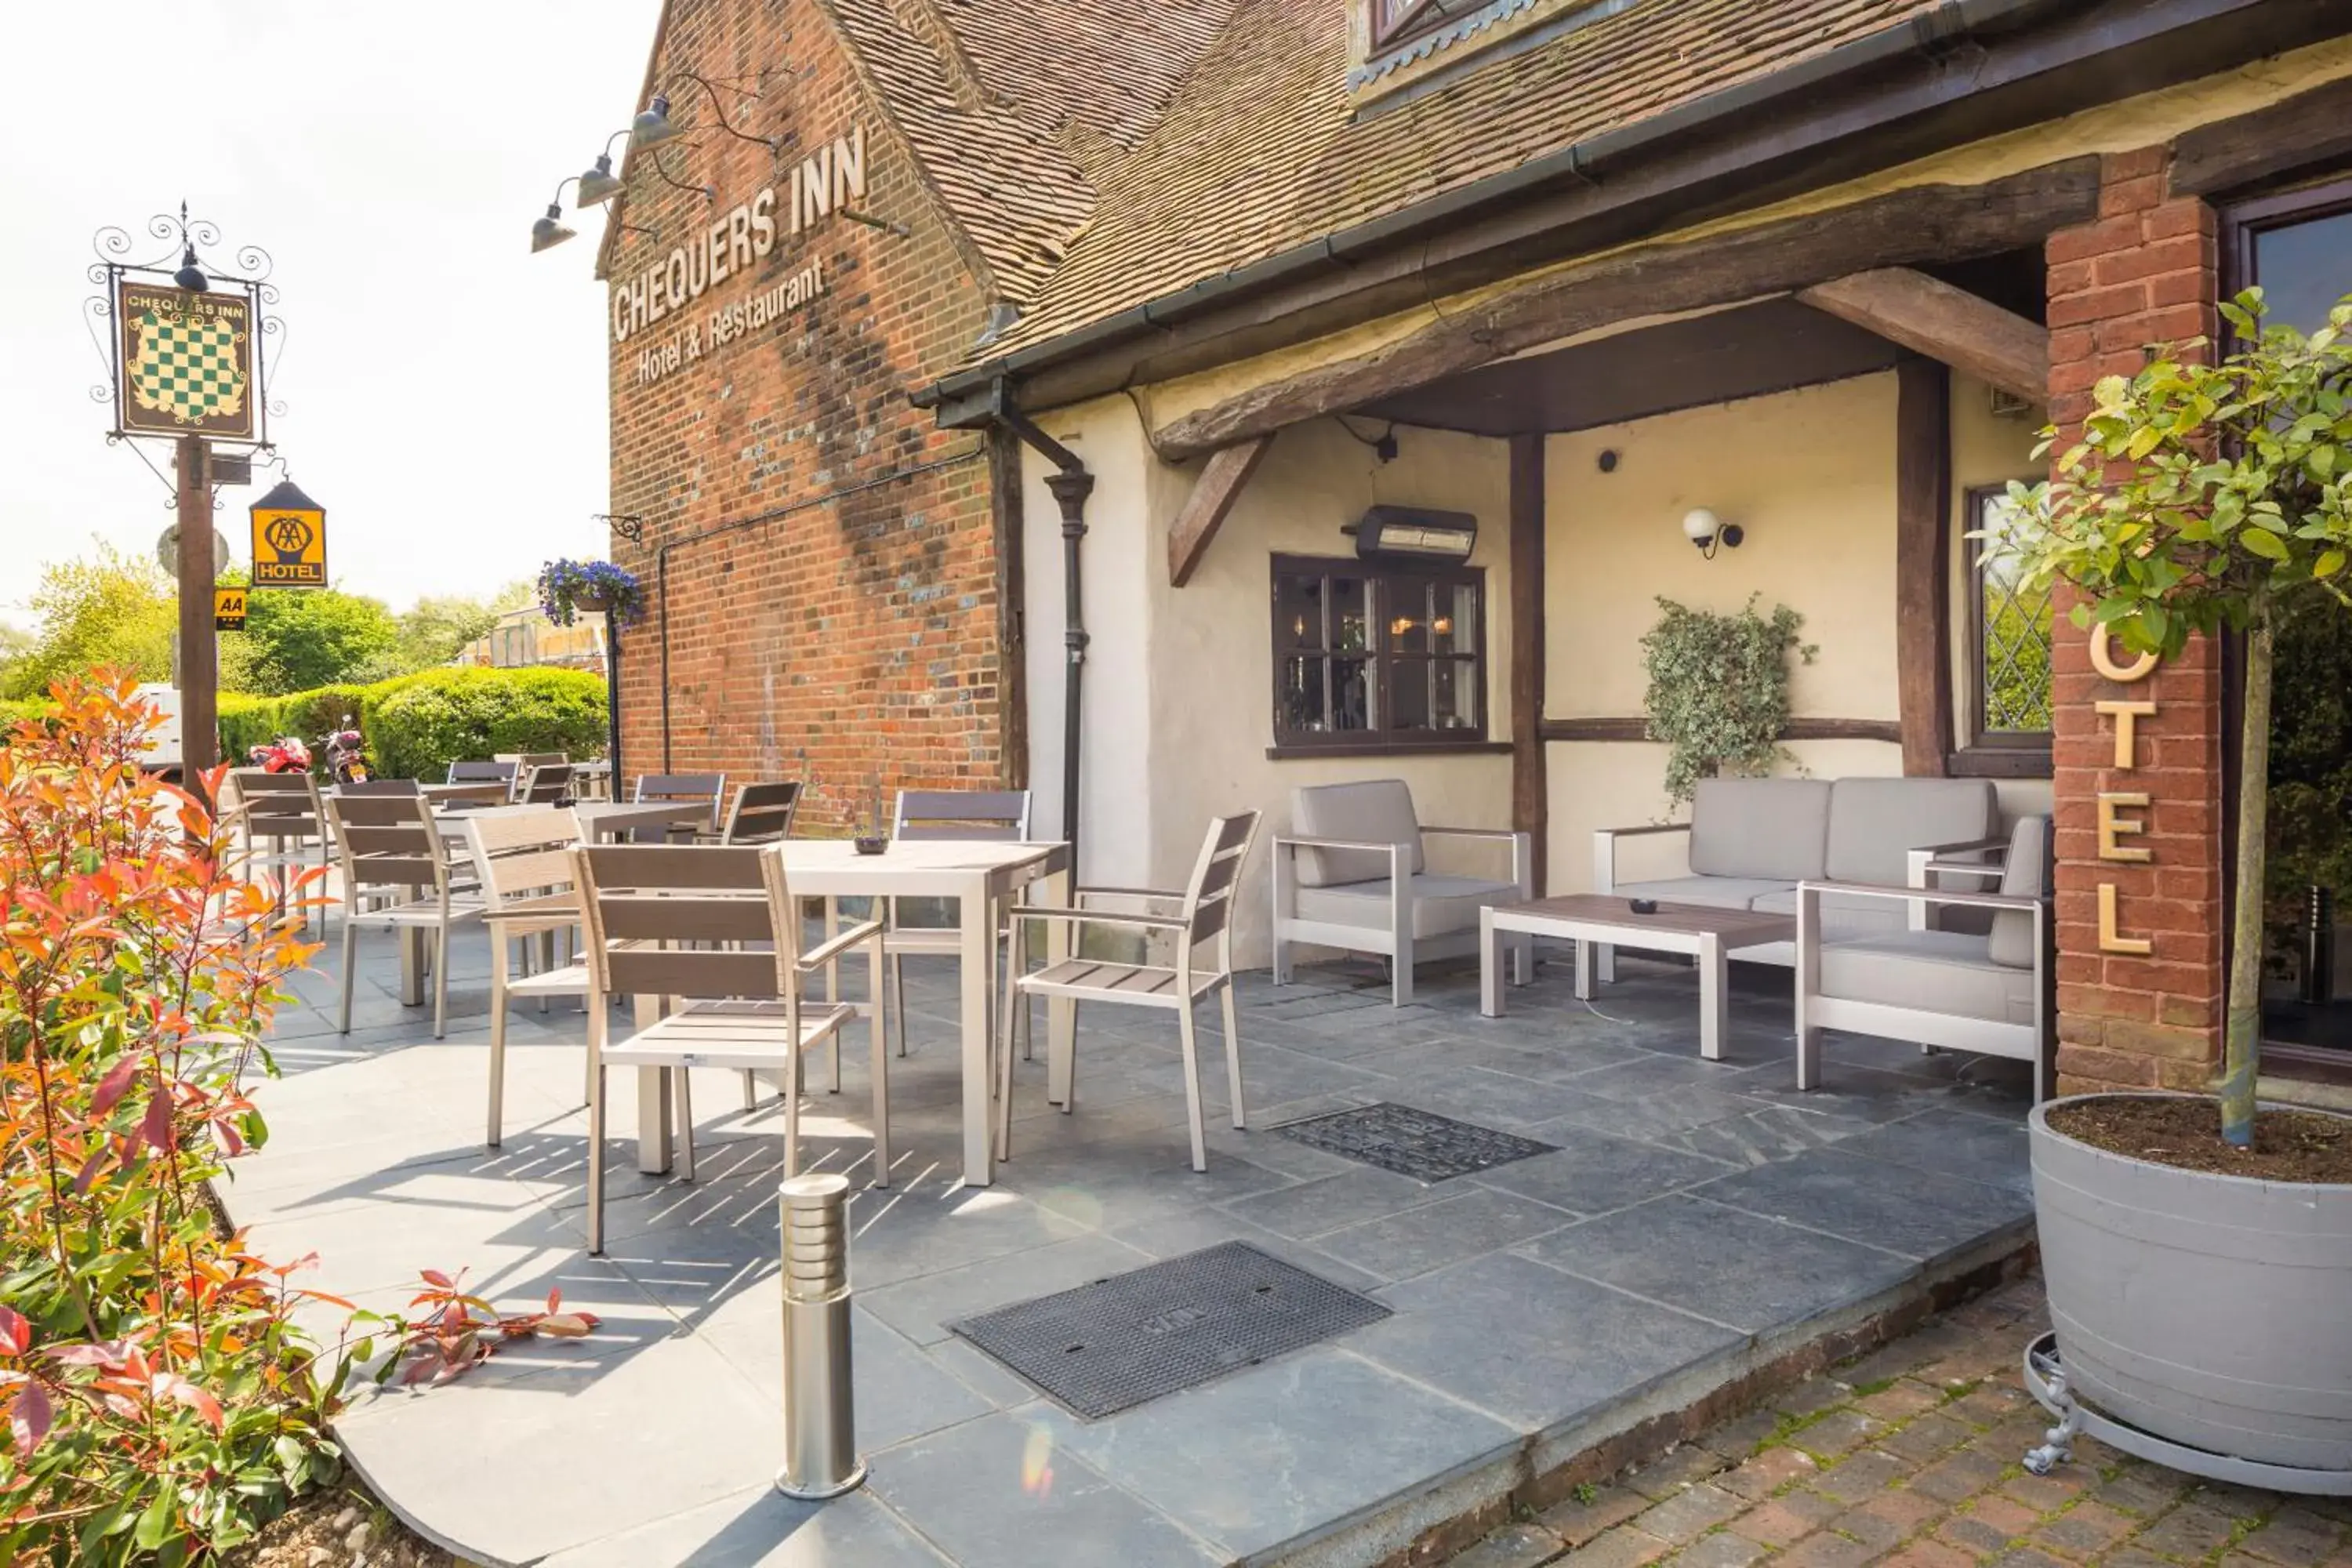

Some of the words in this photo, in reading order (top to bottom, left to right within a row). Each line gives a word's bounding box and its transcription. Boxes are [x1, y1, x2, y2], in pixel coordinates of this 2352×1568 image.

[614, 187, 777, 342] CHEQUERS
[791, 124, 866, 234] INN
[129, 296, 214, 314] CHEQURS
[218, 305, 244, 318] INN
[637, 335, 682, 384] Hotel
[688, 323, 703, 358] &
[709, 254, 825, 350] Restaurant
[220, 597, 242, 612] AA
[260, 564, 320, 578] HOTEL
[2090, 541, 2162, 954] OTEL
